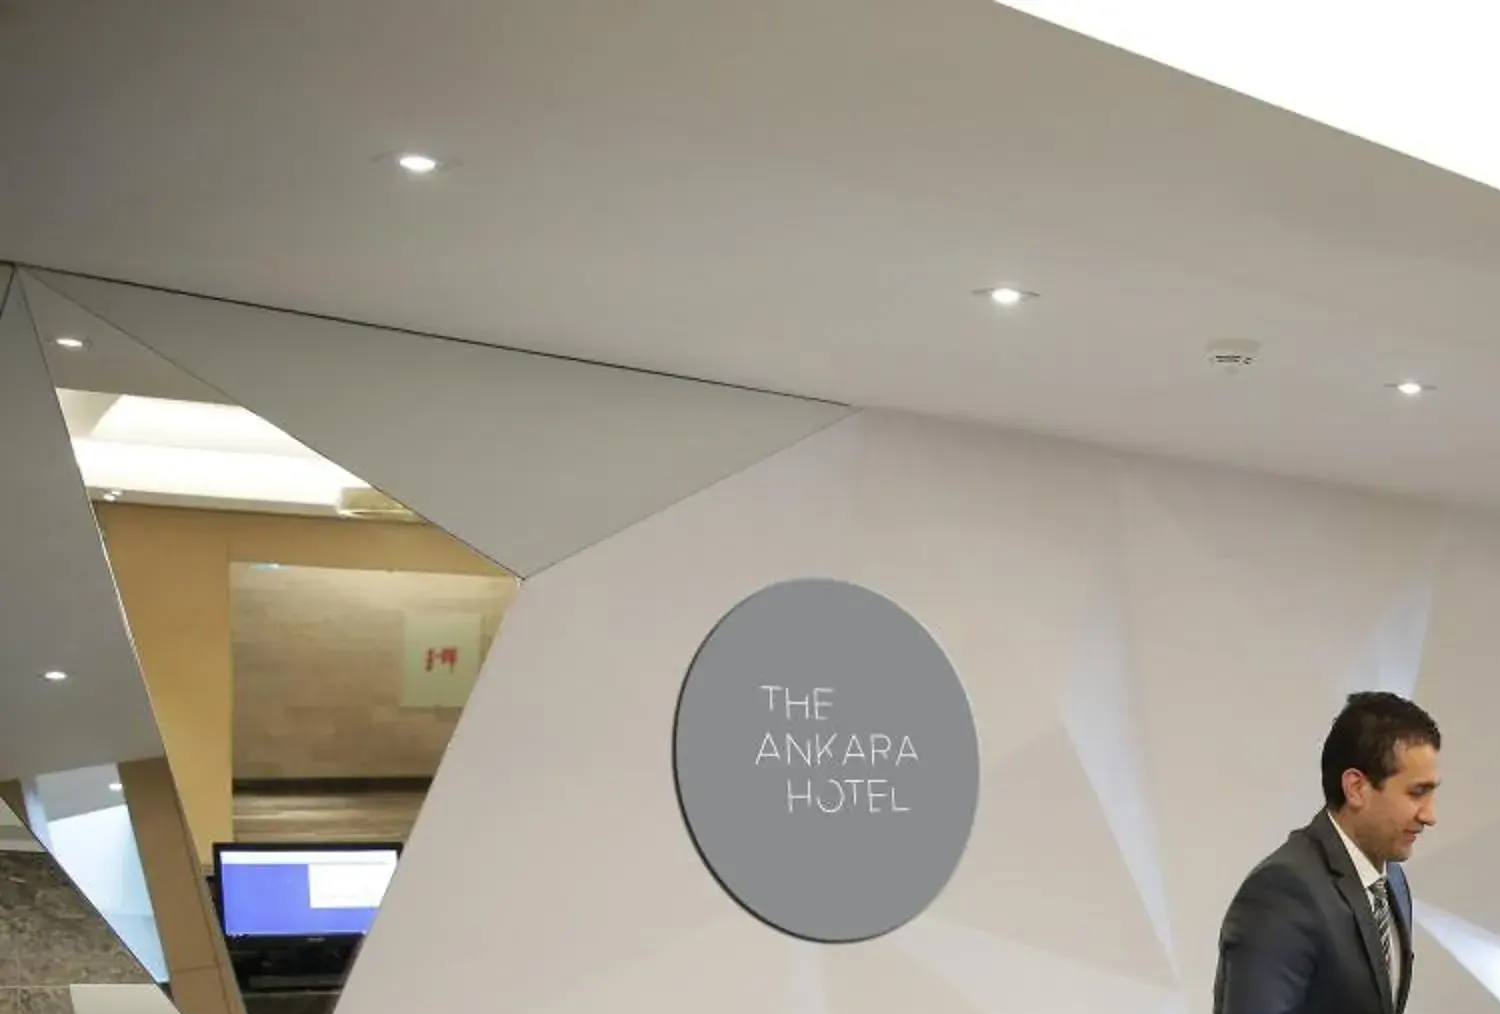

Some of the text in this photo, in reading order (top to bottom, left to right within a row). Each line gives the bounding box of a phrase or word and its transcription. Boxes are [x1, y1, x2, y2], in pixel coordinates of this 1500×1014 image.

[759, 685, 835, 721] THE
[755, 731, 919, 767] ANKARA
[786, 778, 912, 814] HOTEL
